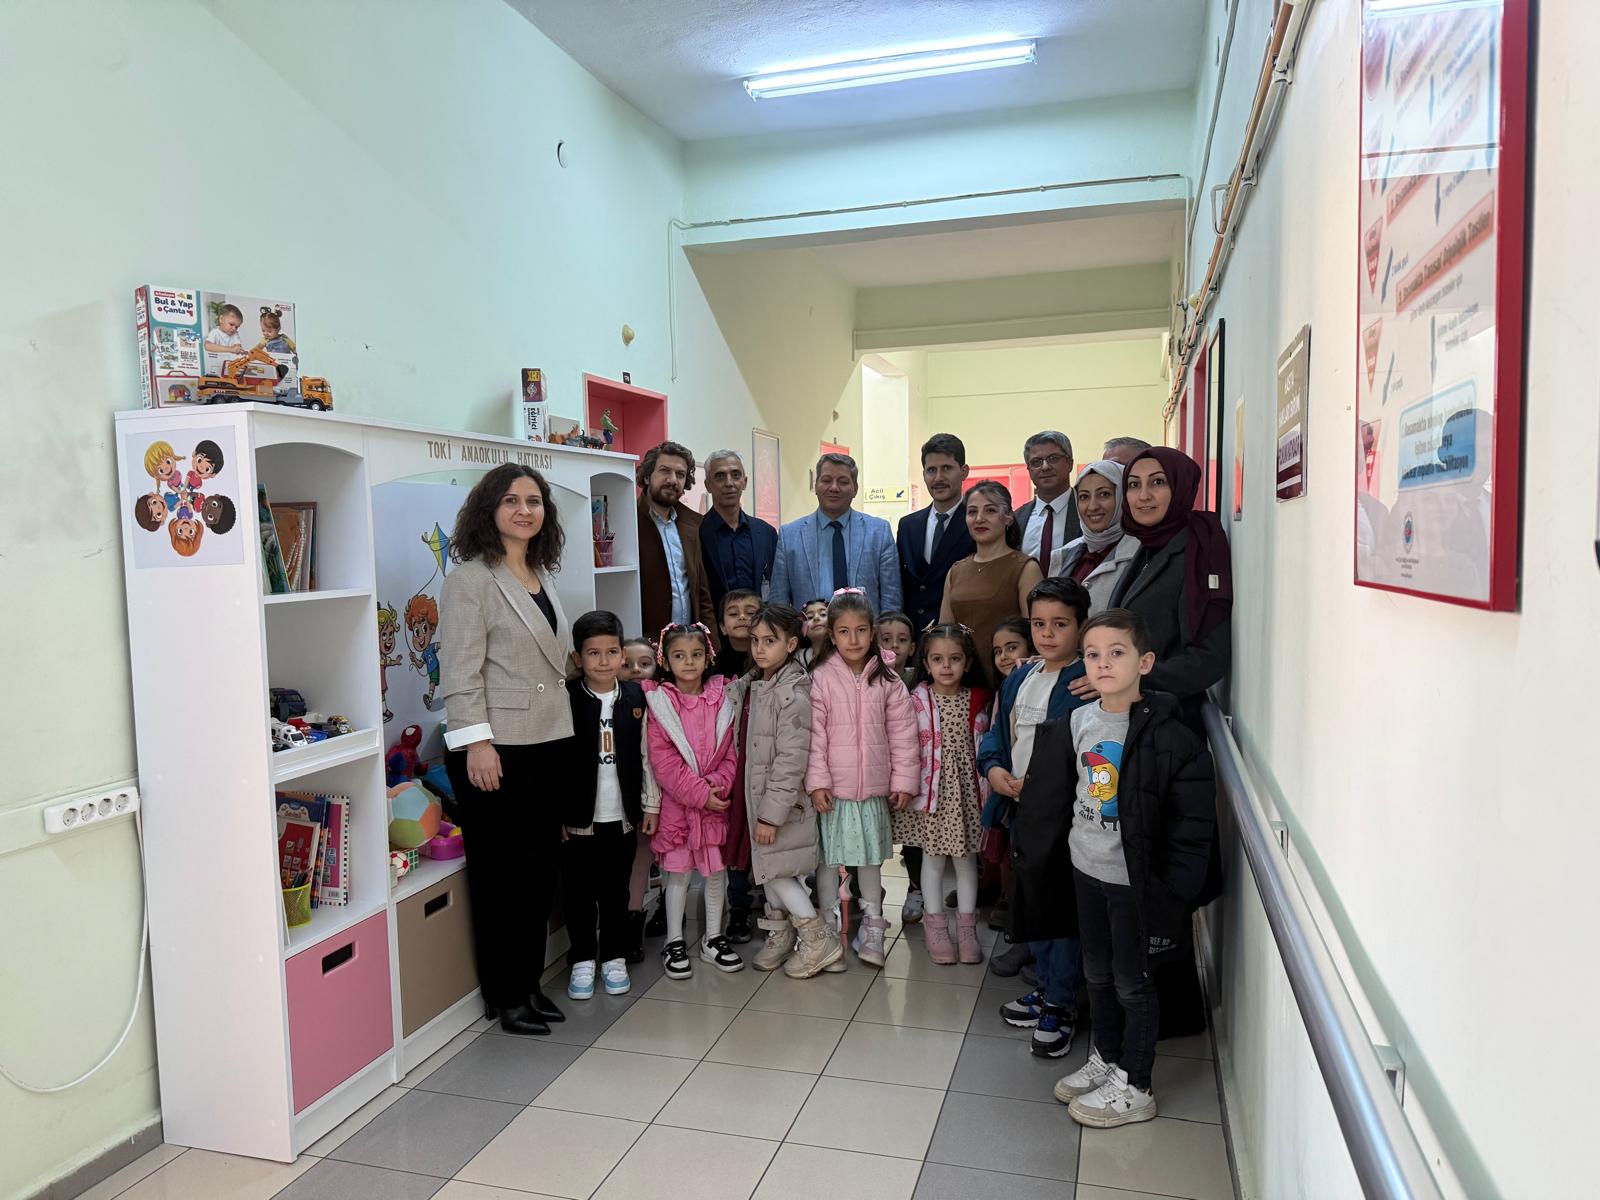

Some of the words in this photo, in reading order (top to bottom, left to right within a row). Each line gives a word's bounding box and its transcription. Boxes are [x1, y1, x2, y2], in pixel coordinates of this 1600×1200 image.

[154, 297, 169, 306] Bul
[178, 300, 193, 309] Yap
[163, 306, 186, 314] Çanta
[427, 440, 452, 460] TOKİ
[461, 445, 509, 465] ANAOKULU
